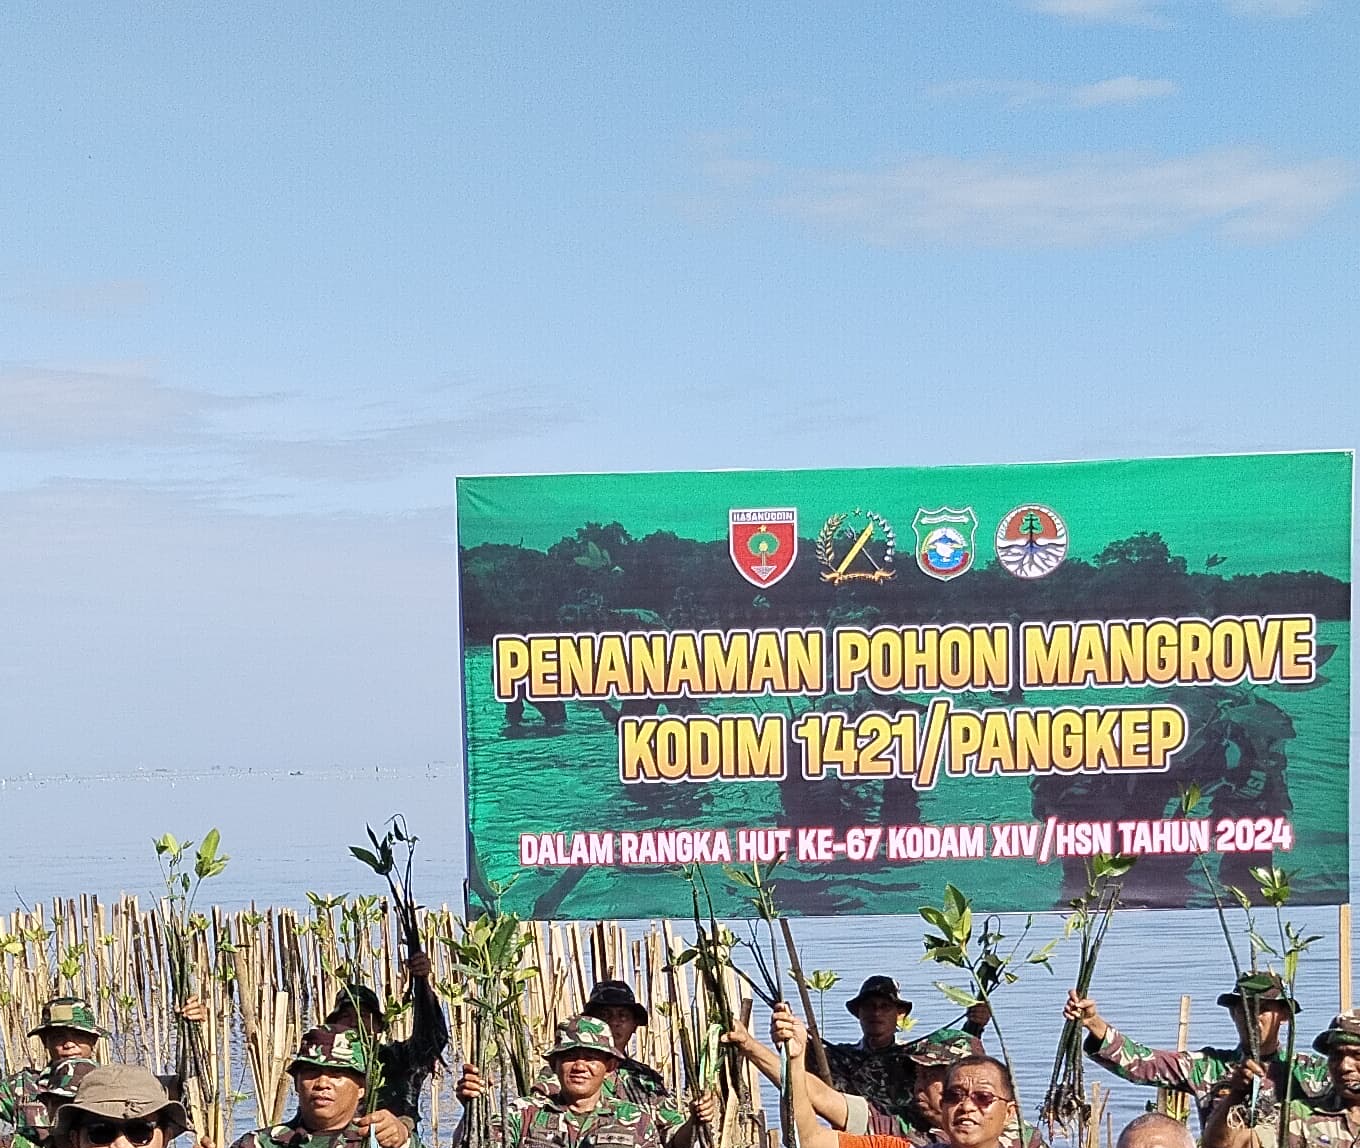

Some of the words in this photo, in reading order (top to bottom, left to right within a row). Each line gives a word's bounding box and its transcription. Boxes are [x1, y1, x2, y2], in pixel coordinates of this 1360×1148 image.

[733, 511, 793, 522] HASANUDDIN
[495, 629, 824, 699] PENANAMAN
[836, 623, 1010, 692] POHON
[1023, 617, 1314, 687] MANGROVE
[621, 716, 784, 780] KODIM
[795, 701, 1185, 787] 1421/PANGKEP
[521, 833, 613, 865] DALAM
[622, 831, 731, 864] RANGKA
[739, 829, 791, 862] HUT
[798, 828, 882, 861] KE-67
[888, 824, 985, 859] KODAM
[992, 817, 1112, 862] XIV/HSN
[1119, 819, 1211, 855] TAHUN
[1217, 817, 1292, 851] 2024
